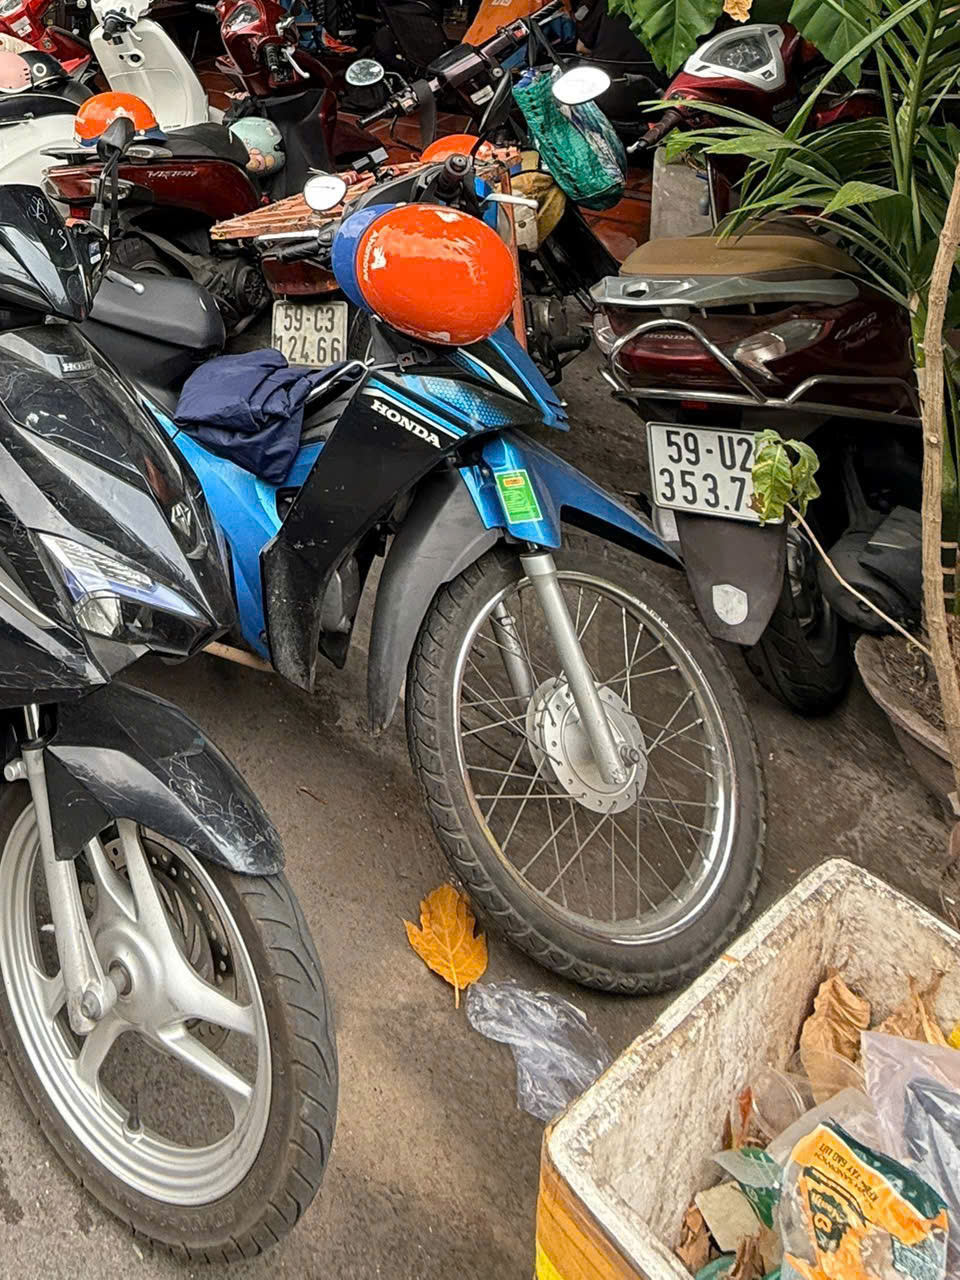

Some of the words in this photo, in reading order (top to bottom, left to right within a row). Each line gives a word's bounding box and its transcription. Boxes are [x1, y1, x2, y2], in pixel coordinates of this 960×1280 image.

[283, 306, 336, 332] 59-C3
[370, 399, 441, 449] HONDA
[665, 430, 754, 473] 59-U2
[659, 468, 747, 511] 353.7
